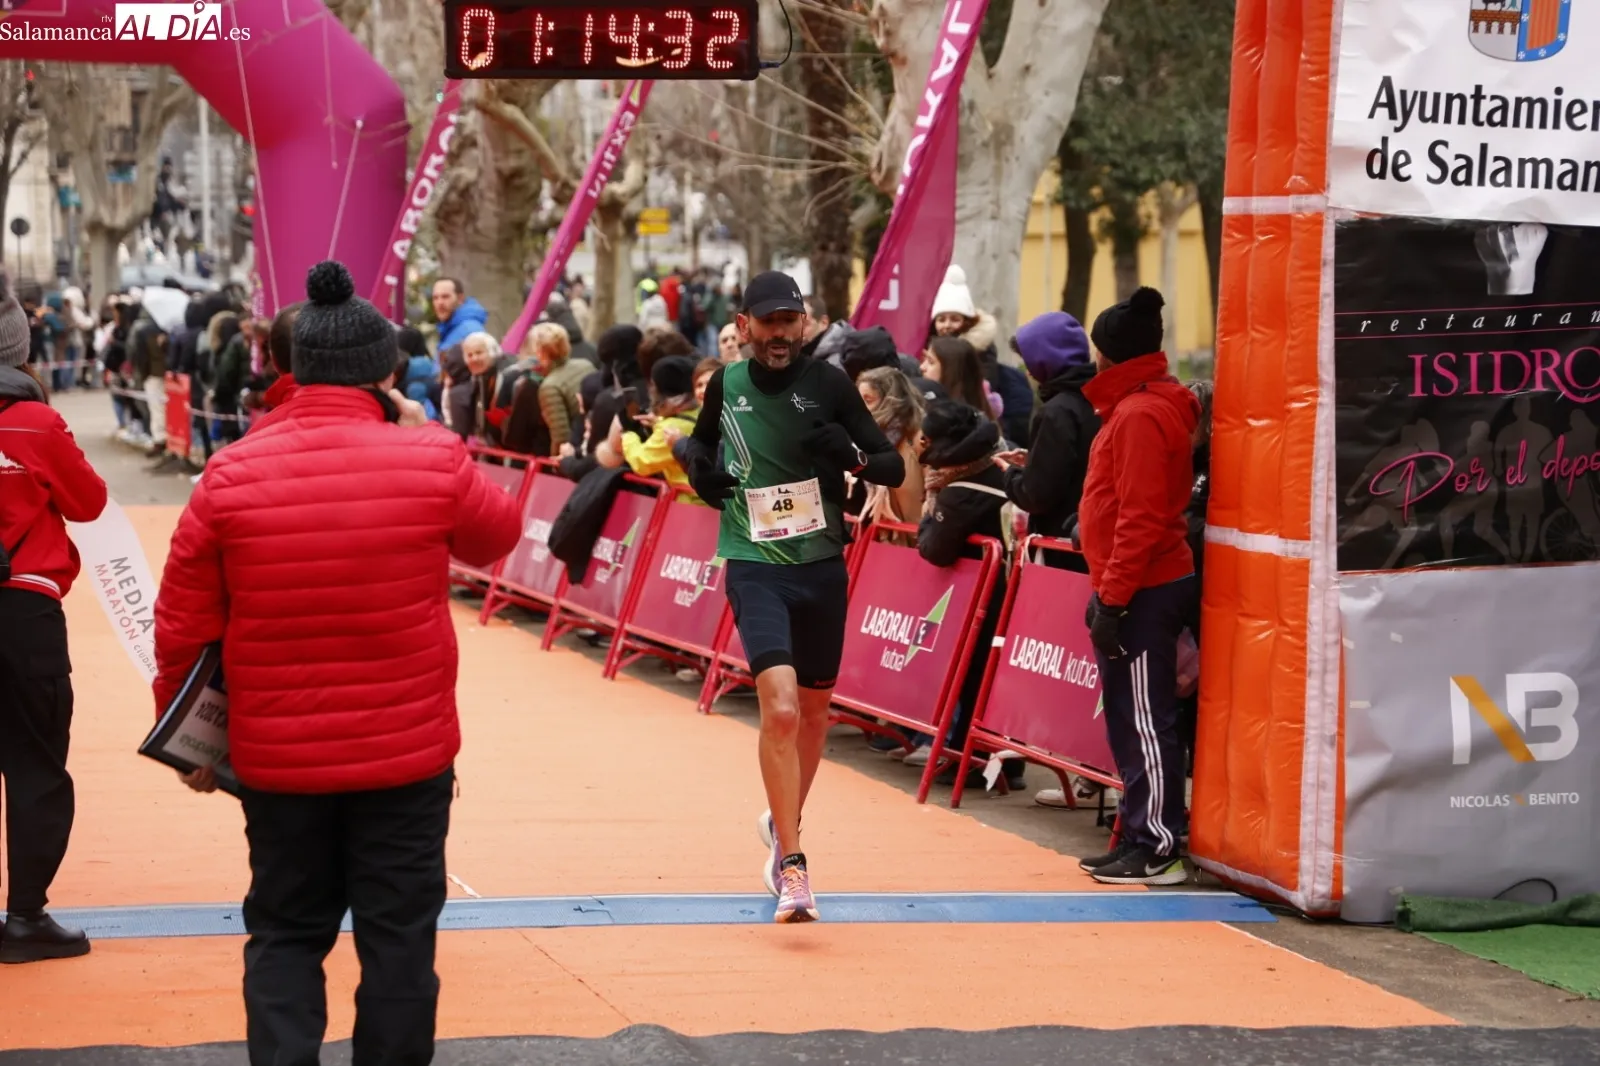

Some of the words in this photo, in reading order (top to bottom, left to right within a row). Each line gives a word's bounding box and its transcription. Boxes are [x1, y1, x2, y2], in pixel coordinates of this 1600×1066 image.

[1365, 136, 1412, 182] de
[1506, 439, 1527, 486] el
[772, 498, 794, 512] 48
[95, 563, 139, 641] MARATÓN
[109, 556, 155, 633] MEDIA
[860, 605, 914, 646] LABORAL
[880, 646, 904, 672] kutxa
[1009, 635, 1065, 680] LABORAL
[1063, 651, 1099, 689] kutxa
[1450, 795, 1510, 808] NICOLAS
[1529, 792, 1580, 806] BENITO
